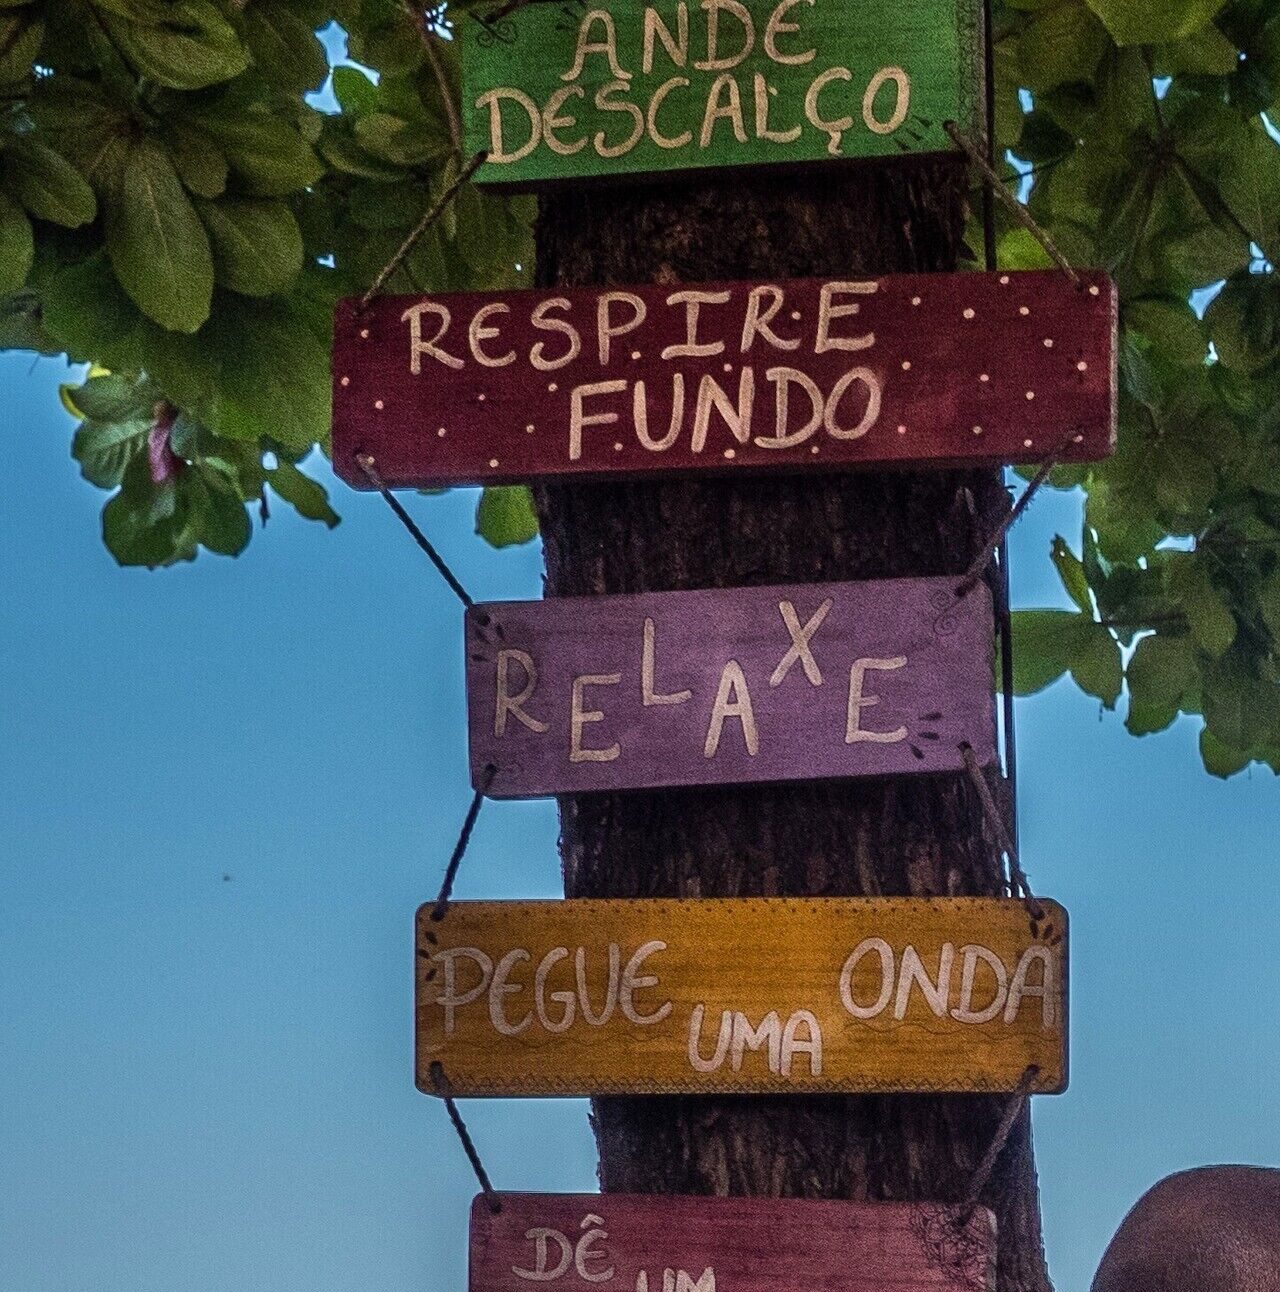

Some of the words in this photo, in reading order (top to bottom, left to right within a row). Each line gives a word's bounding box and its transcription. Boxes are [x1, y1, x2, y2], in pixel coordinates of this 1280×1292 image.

[560, 0, 819, 81] ANDE
[474, 66, 911, 165] DESCALÇO
[401, 281, 879, 375] RESPIRE
[569, 366, 884, 461] FUNDO
[492, 598, 909, 763] RELAXE
[430, 940, 672, 1036] PEGUE
[687, 1003, 823, 1077] UMA
[838, 938, 1060, 1032] ONDA
[511, 1214, 614, 1282] DÊ
